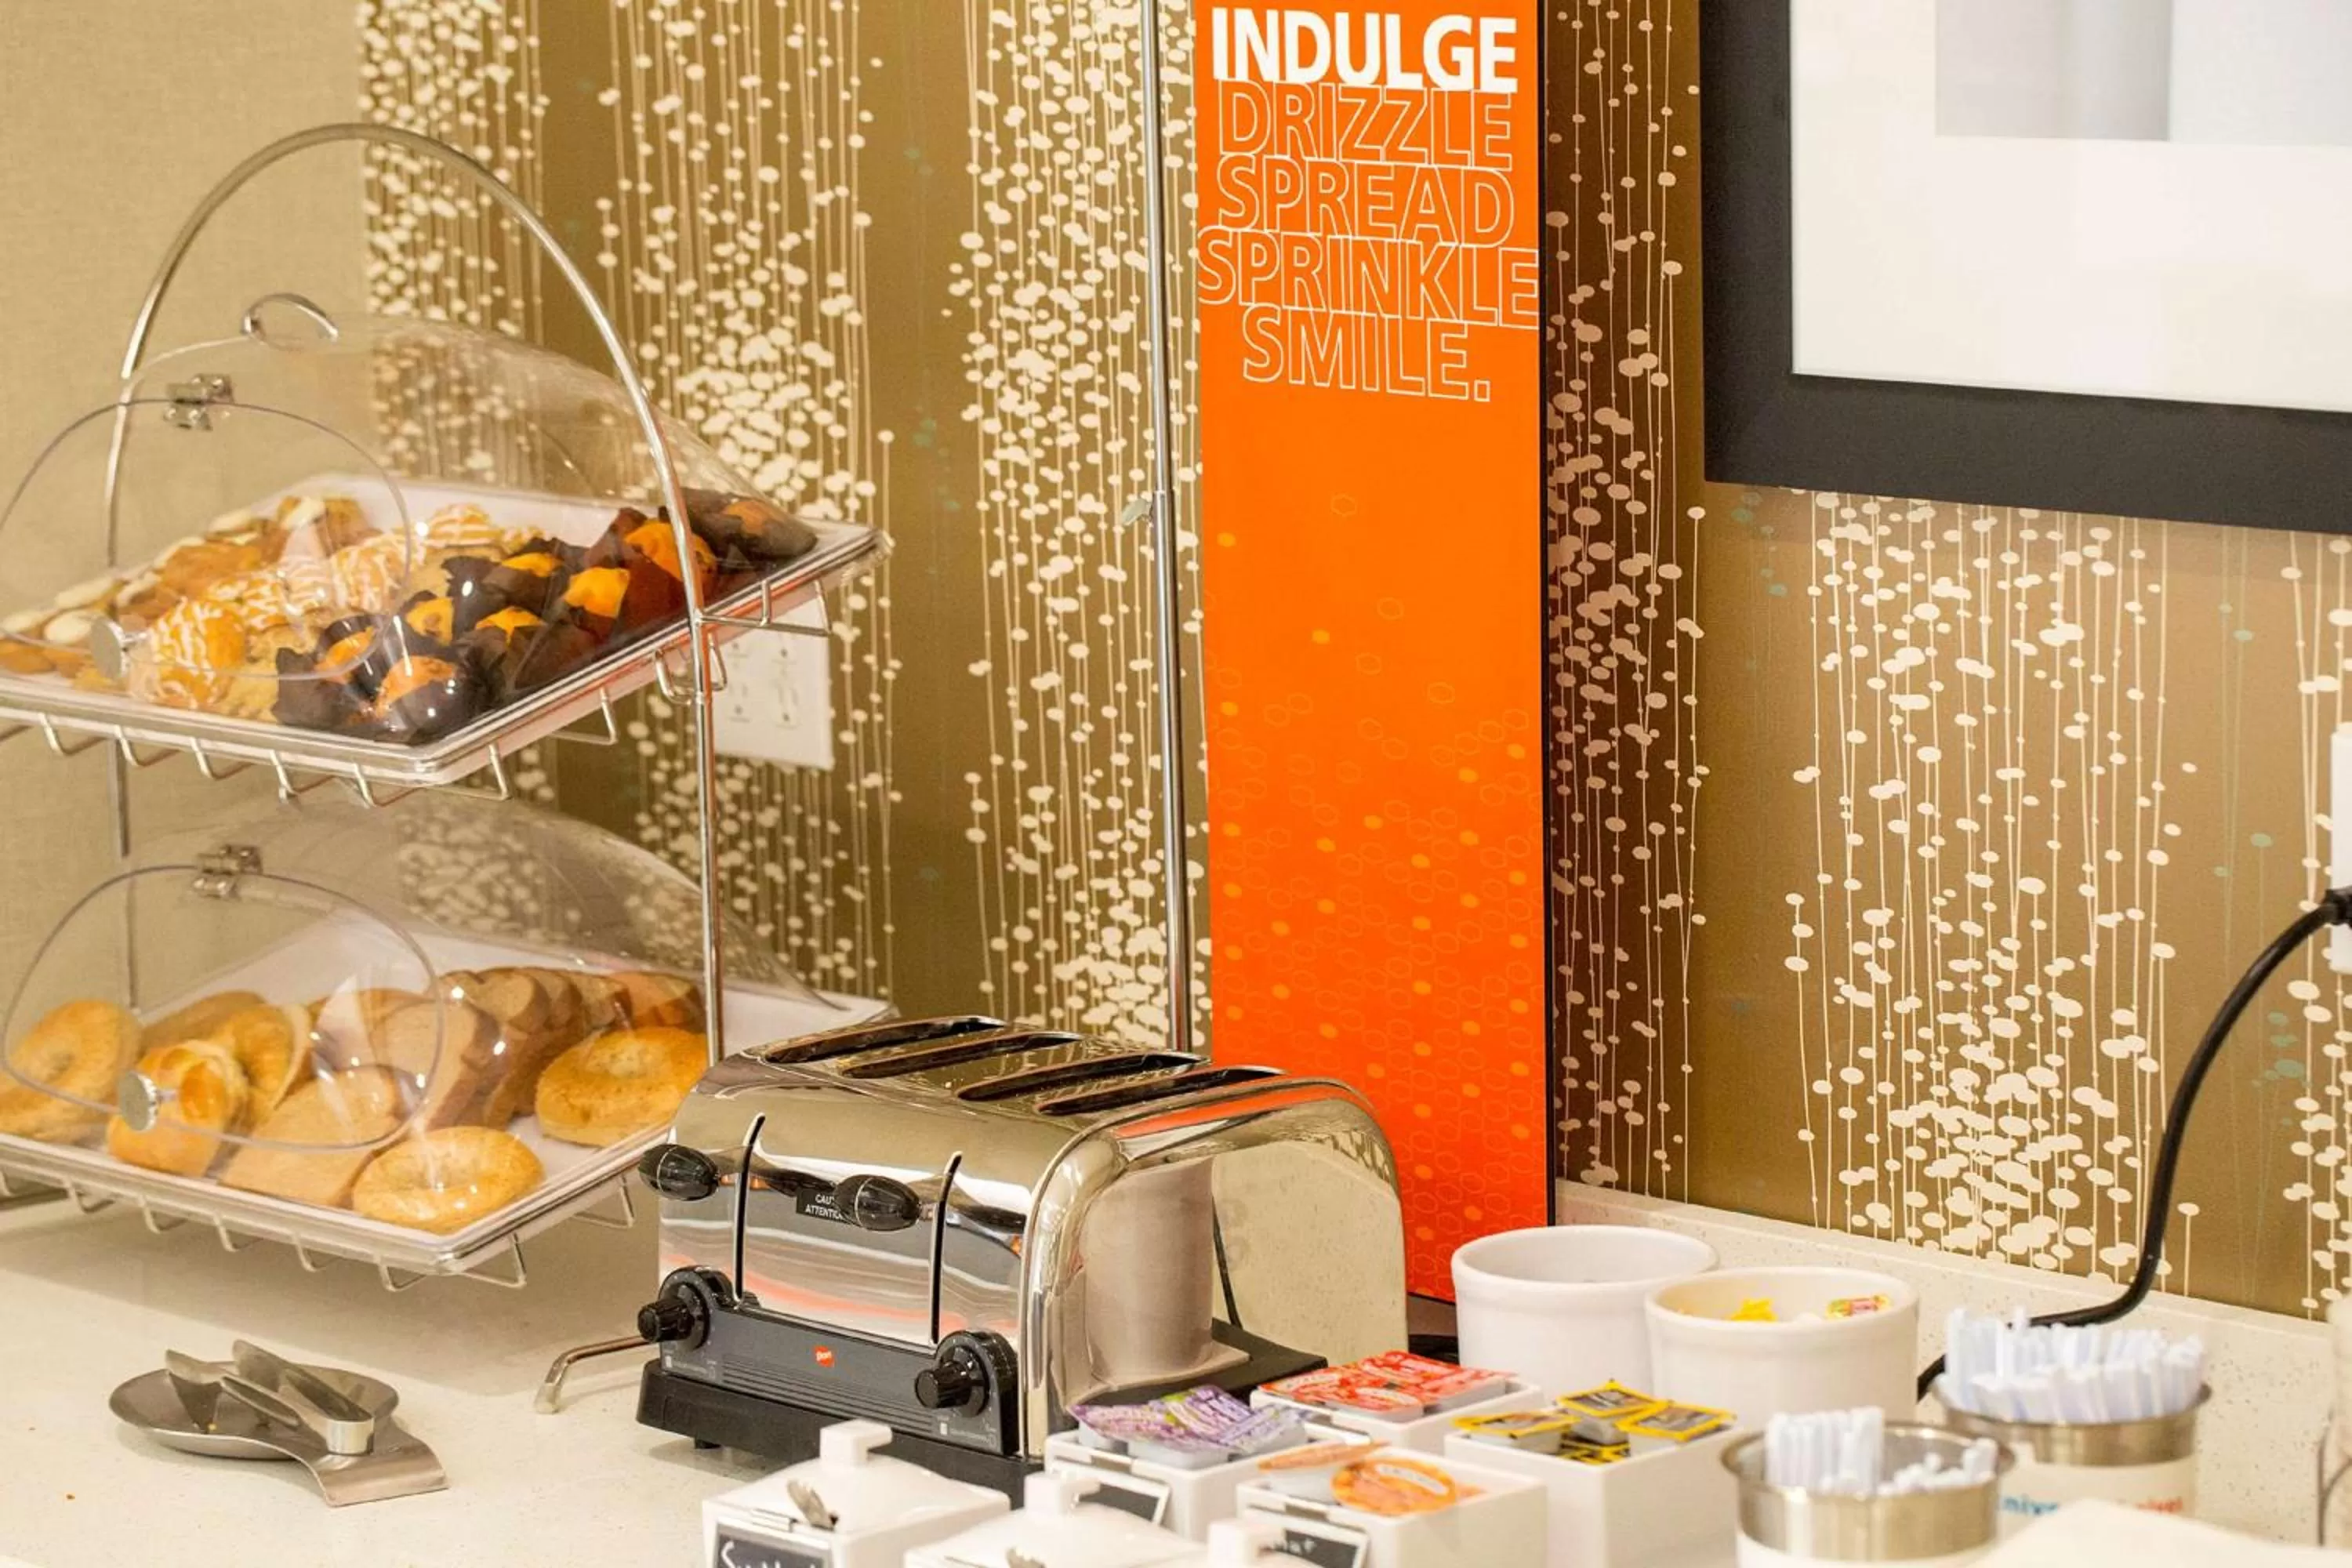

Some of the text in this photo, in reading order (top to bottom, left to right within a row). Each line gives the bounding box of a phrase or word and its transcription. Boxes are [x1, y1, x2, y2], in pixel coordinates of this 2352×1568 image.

[1212, 7, 1517, 93] INDULGE
[1219, 79, 1512, 171] DRIZZLE
[1217, 153, 1514, 248] SPREAD
[1198, 225, 1539, 329] SPRINKLE
[1243, 303, 1490, 402] SMILE.
